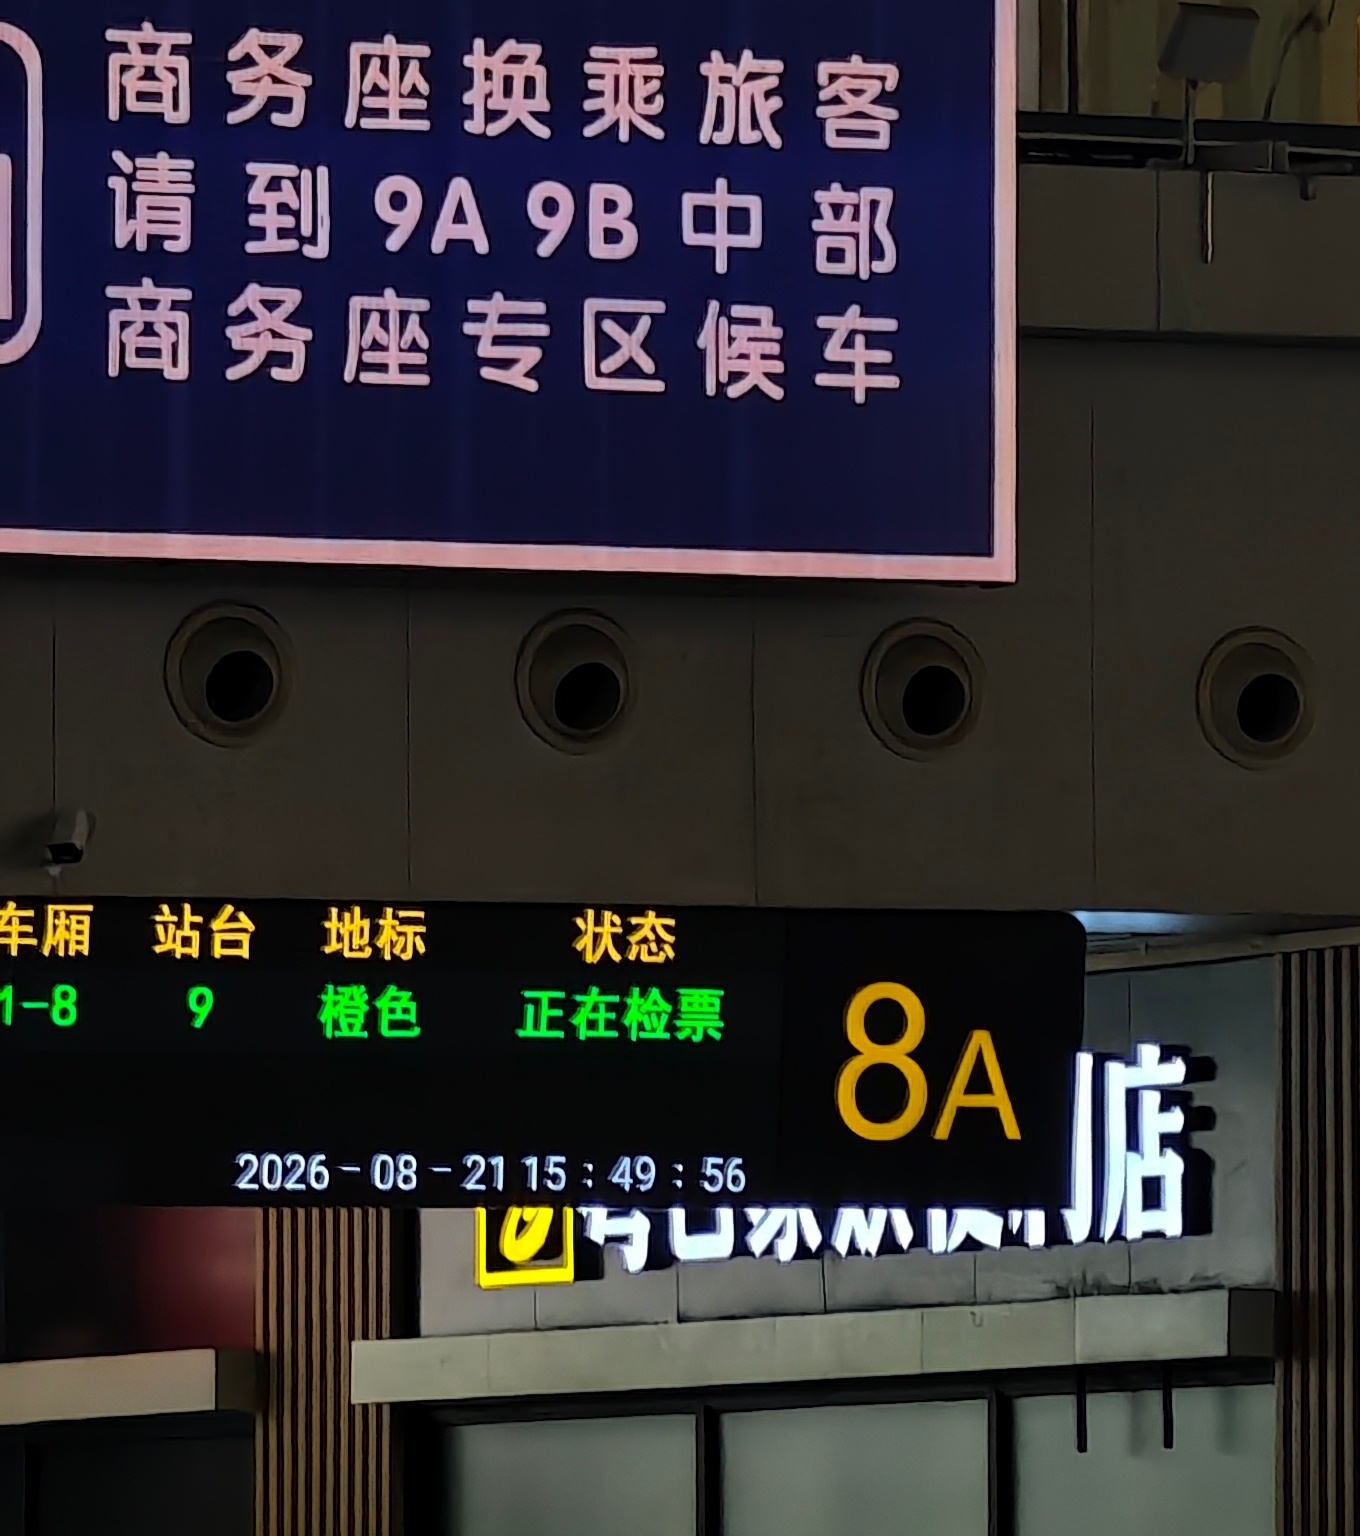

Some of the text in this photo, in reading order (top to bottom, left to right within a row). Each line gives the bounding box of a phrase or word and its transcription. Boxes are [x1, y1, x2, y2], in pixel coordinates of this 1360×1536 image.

[105, 21, 900, 150] 商务座换乘旅客
[105, 277, 900, 404] 商务座专区候车
[0, 900, 676, 964] 车厢 站台 地标 状态
[187, 985, 214, 1029] 9
[318, 984, 421, 1039] 橙色
[516, 985, 725, 1043] 正在检票
[837, 981, 1022, 1141] 8A
